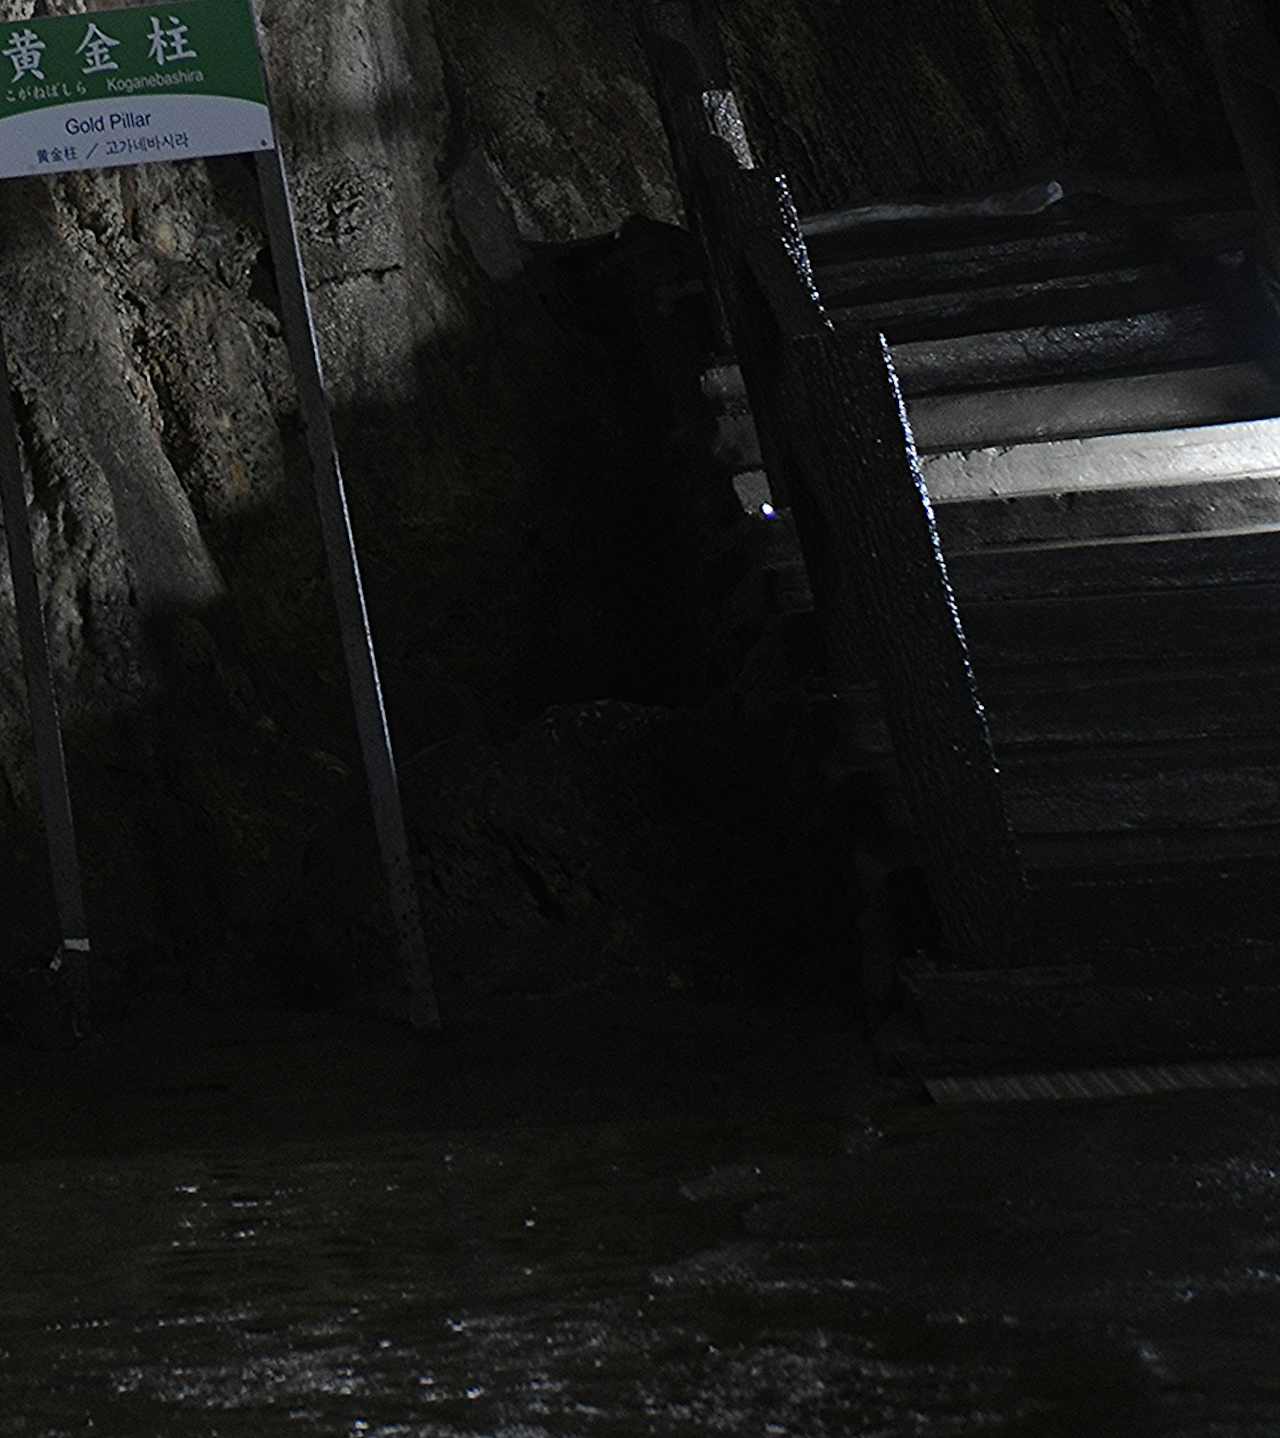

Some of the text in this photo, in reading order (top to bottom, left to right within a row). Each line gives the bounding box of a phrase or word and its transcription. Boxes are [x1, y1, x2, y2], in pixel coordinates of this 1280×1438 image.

[2, 16, 197, 83] 黄金柱
[106, 70, 205, 94] Koganebashira
[6, 84, 87, 103] こがねばしら
[65, 113, 152, 135] Gold Pillar
[106, 134, 190, 156] 고가네바시라
